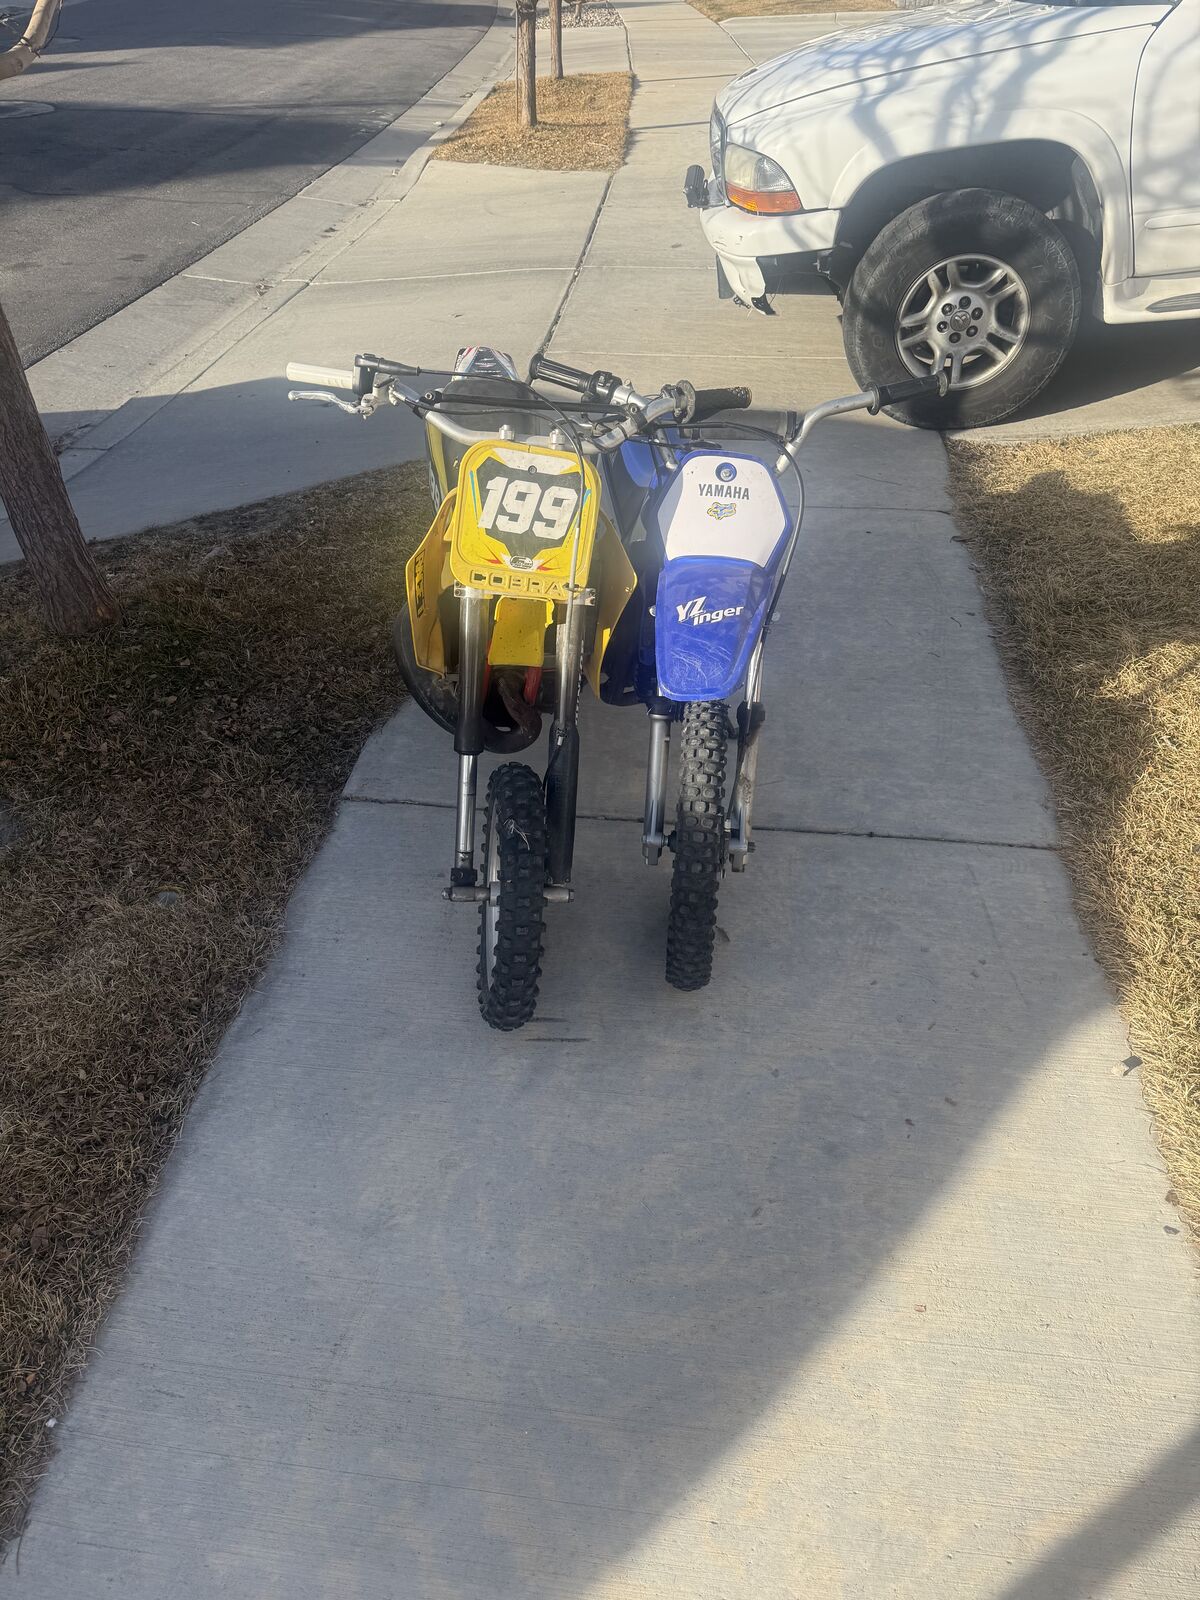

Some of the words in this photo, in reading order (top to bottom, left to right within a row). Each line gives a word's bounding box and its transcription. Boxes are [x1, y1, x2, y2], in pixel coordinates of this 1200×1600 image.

[698, 483, 750, 500] YAMAHA
[478, 476, 578, 540] 199
[470, 570, 563, 597] COBRA
